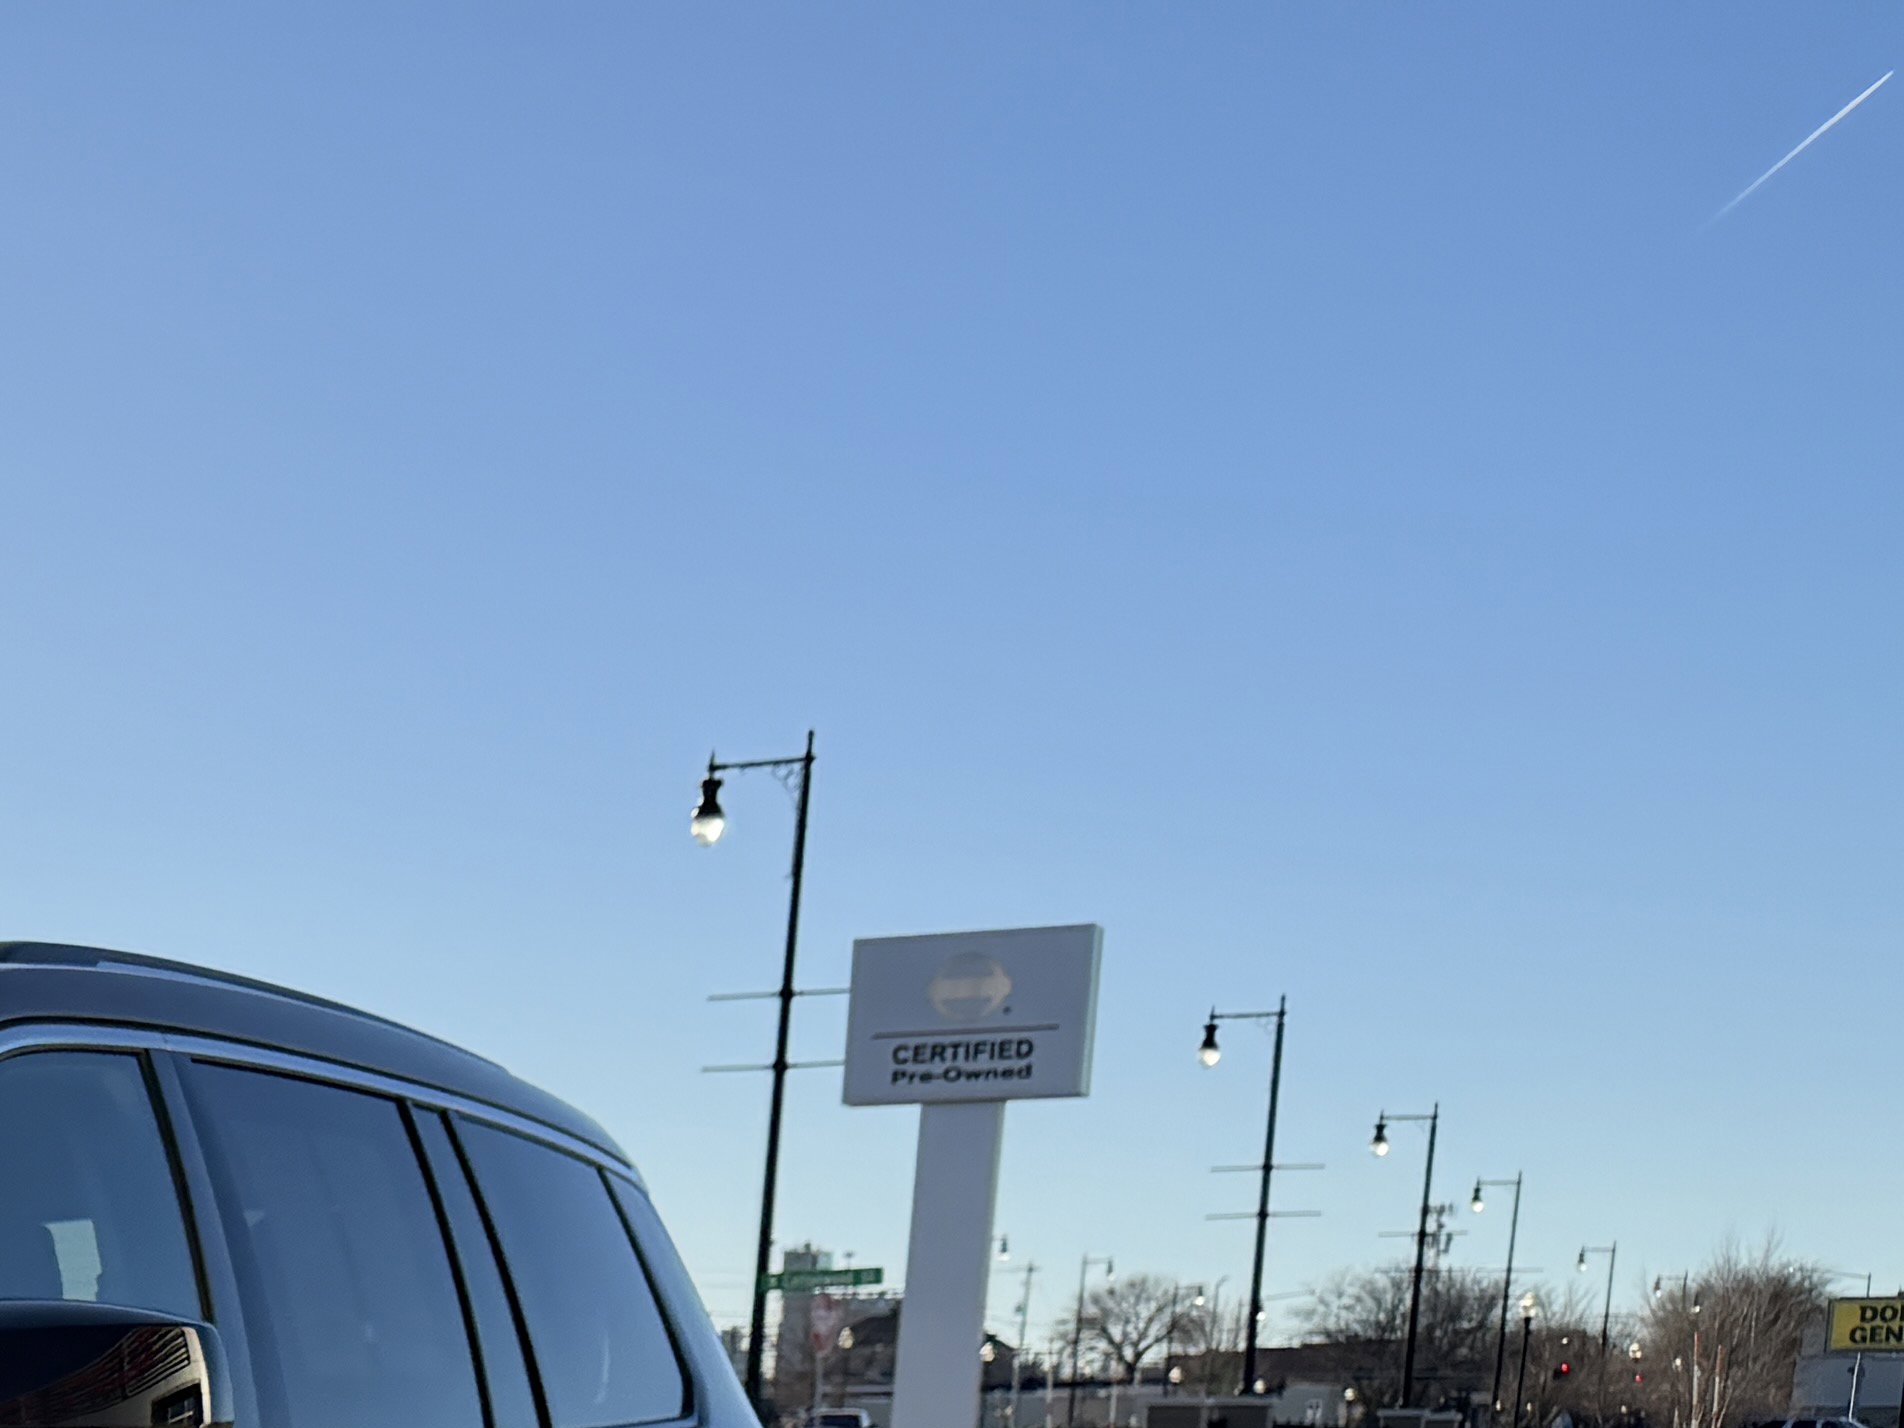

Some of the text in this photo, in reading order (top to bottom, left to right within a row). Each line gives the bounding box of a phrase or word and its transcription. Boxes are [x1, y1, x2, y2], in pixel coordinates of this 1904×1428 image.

[892, 1037, 1034, 1066] CERTIFIED
[891, 1062, 1033, 1086] Pre-Owned
[1859, 1305, 1904, 1323] DO
[1849, 1325, 1903, 1344] GEN
